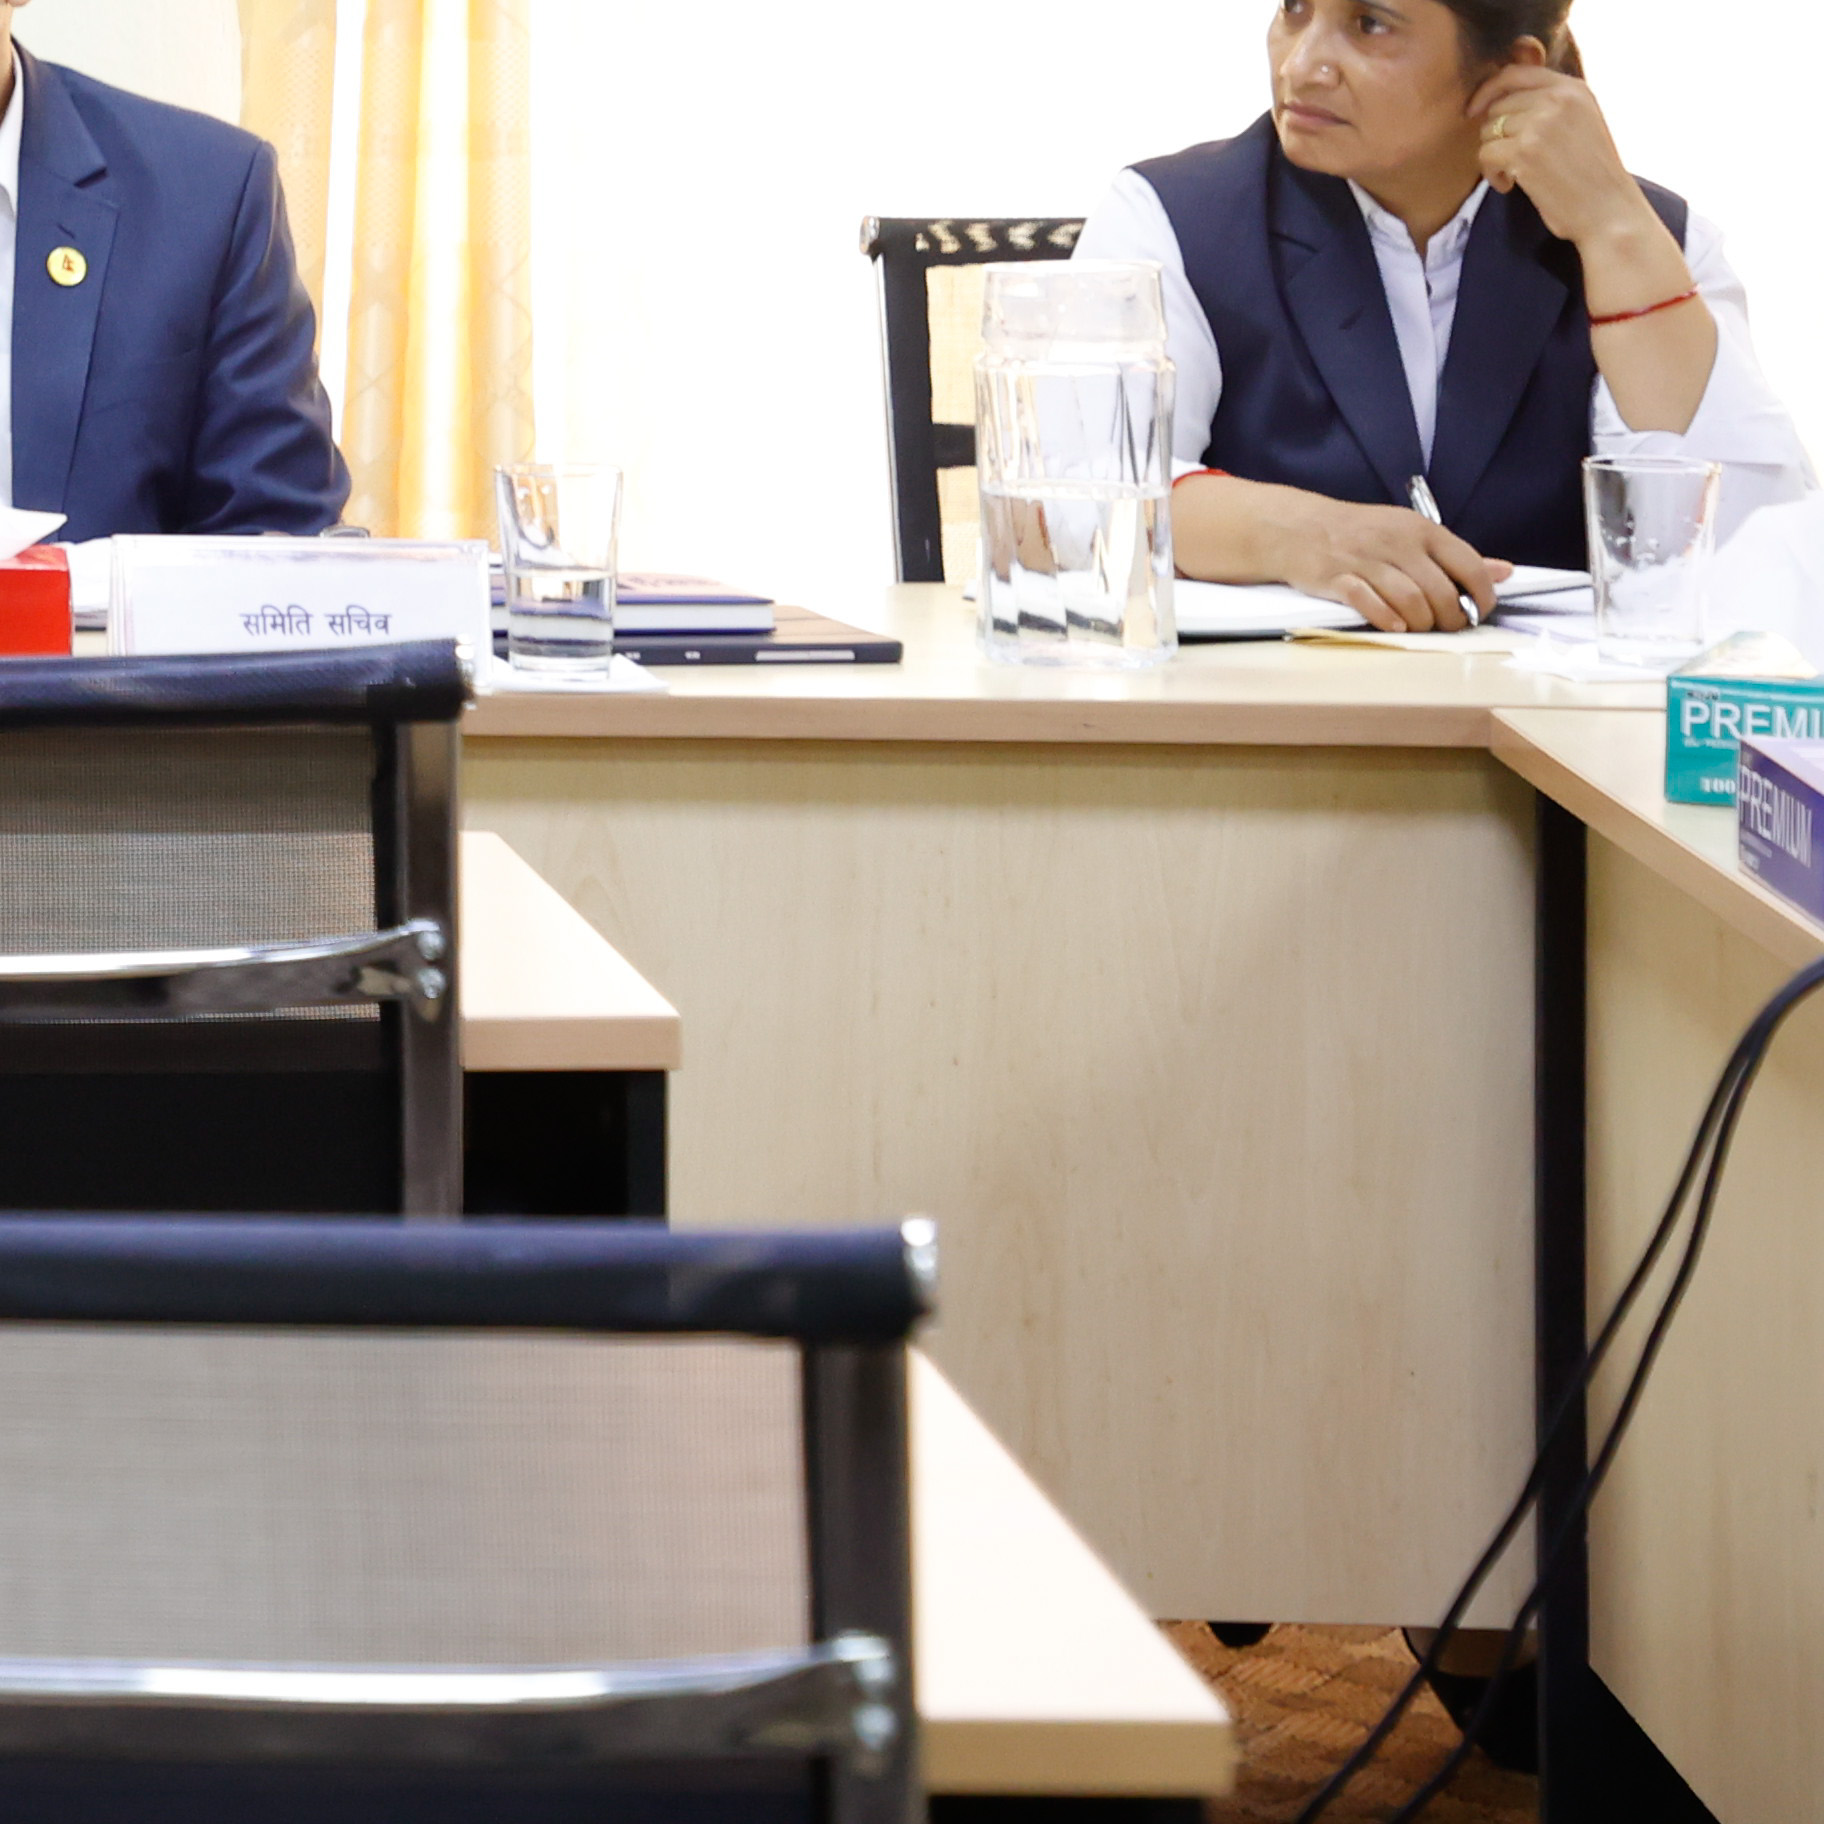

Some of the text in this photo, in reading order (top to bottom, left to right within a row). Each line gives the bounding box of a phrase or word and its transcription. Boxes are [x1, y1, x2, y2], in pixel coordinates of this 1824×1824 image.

[240, 604, 392, 636] समिति सचिव
[1681, 701, 1821, 740] PREMI
[1739, 763, 1812, 868] PREMIUM
